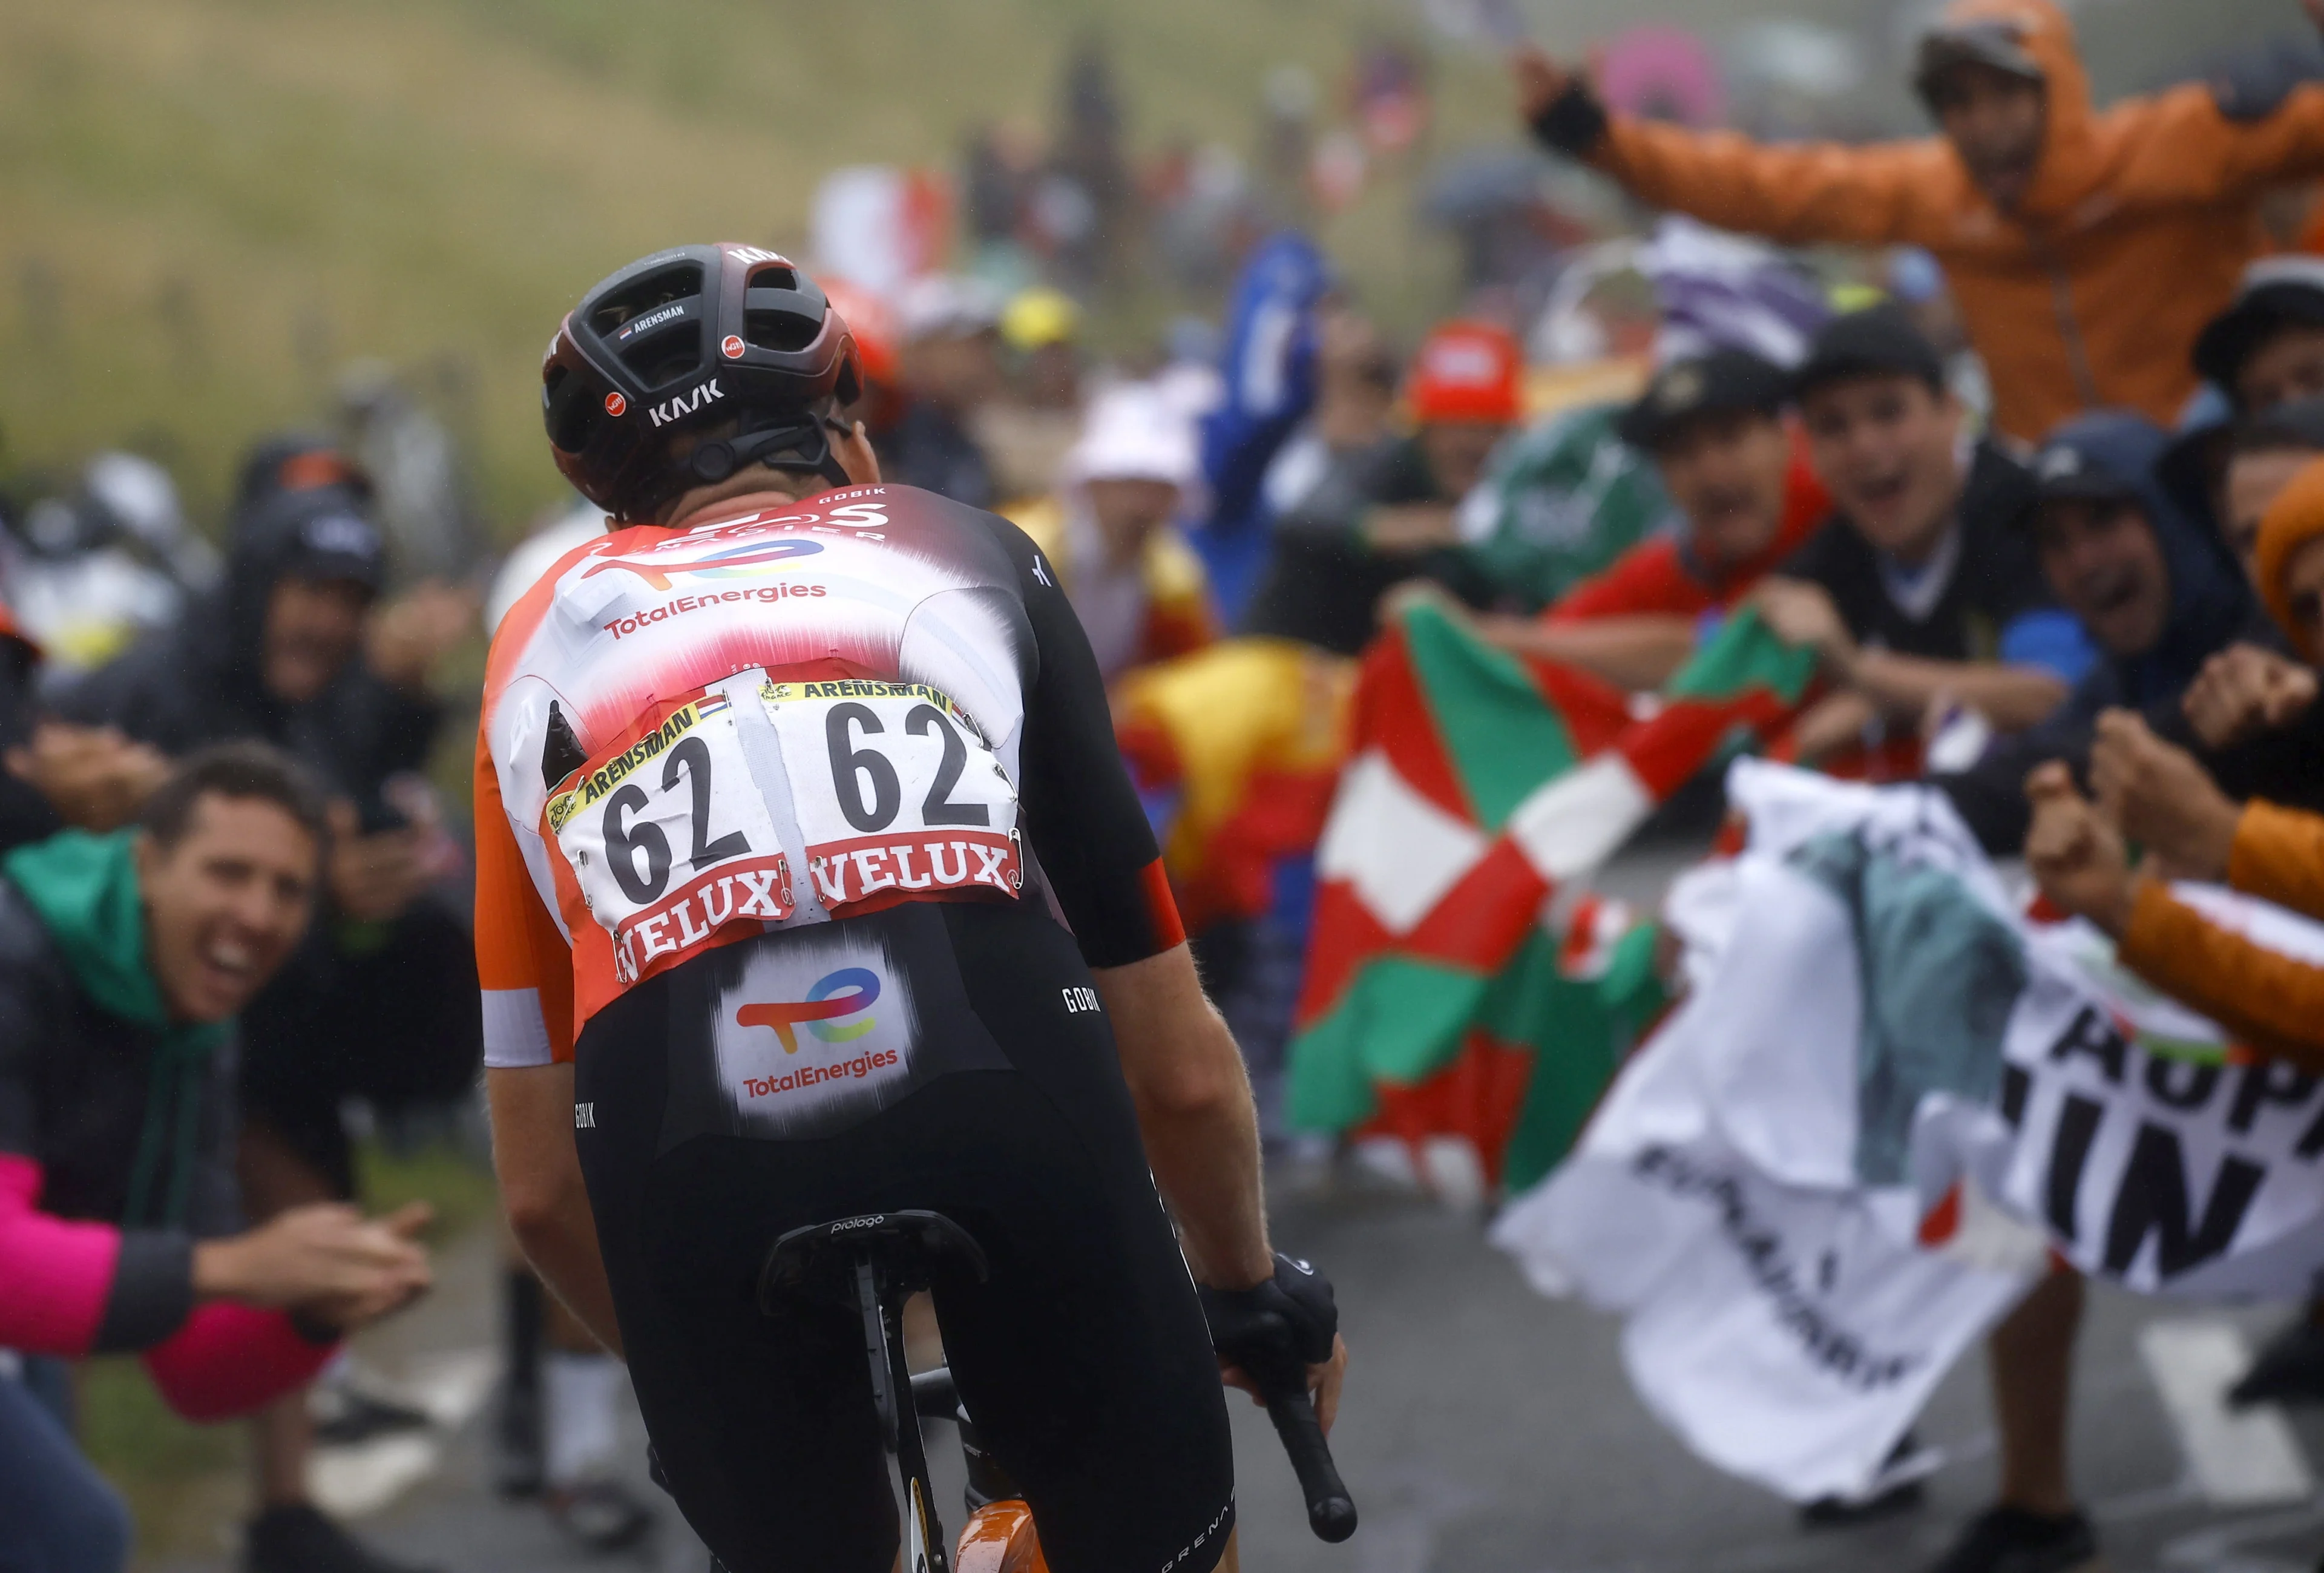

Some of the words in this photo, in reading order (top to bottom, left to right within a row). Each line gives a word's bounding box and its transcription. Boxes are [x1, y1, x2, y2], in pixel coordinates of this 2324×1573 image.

[634, 305, 684, 334] ARENSMAN
[648, 378, 725, 427] KASK
[819, 488, 886, 504] GOBIK
[603, 582, 827, 640] TotalEnergies
[804, 680, 947, 714] ARENSMAN
[585, 708, 694, 805] ARENSMAN
[825, 702, 991, 833] 62
[602, 736, 752, 905] 62
[809, 841, 1010, 902] VELUX
[617, 870, 782, 982] VELUX
[1062, 987, 1101, 1013] GOBIK
[743, 1049, 898, 1098] TotalEnergies
[576, 1102, 596, 1129] GOBIK
[831, 1215, 884, 1234] prologo
